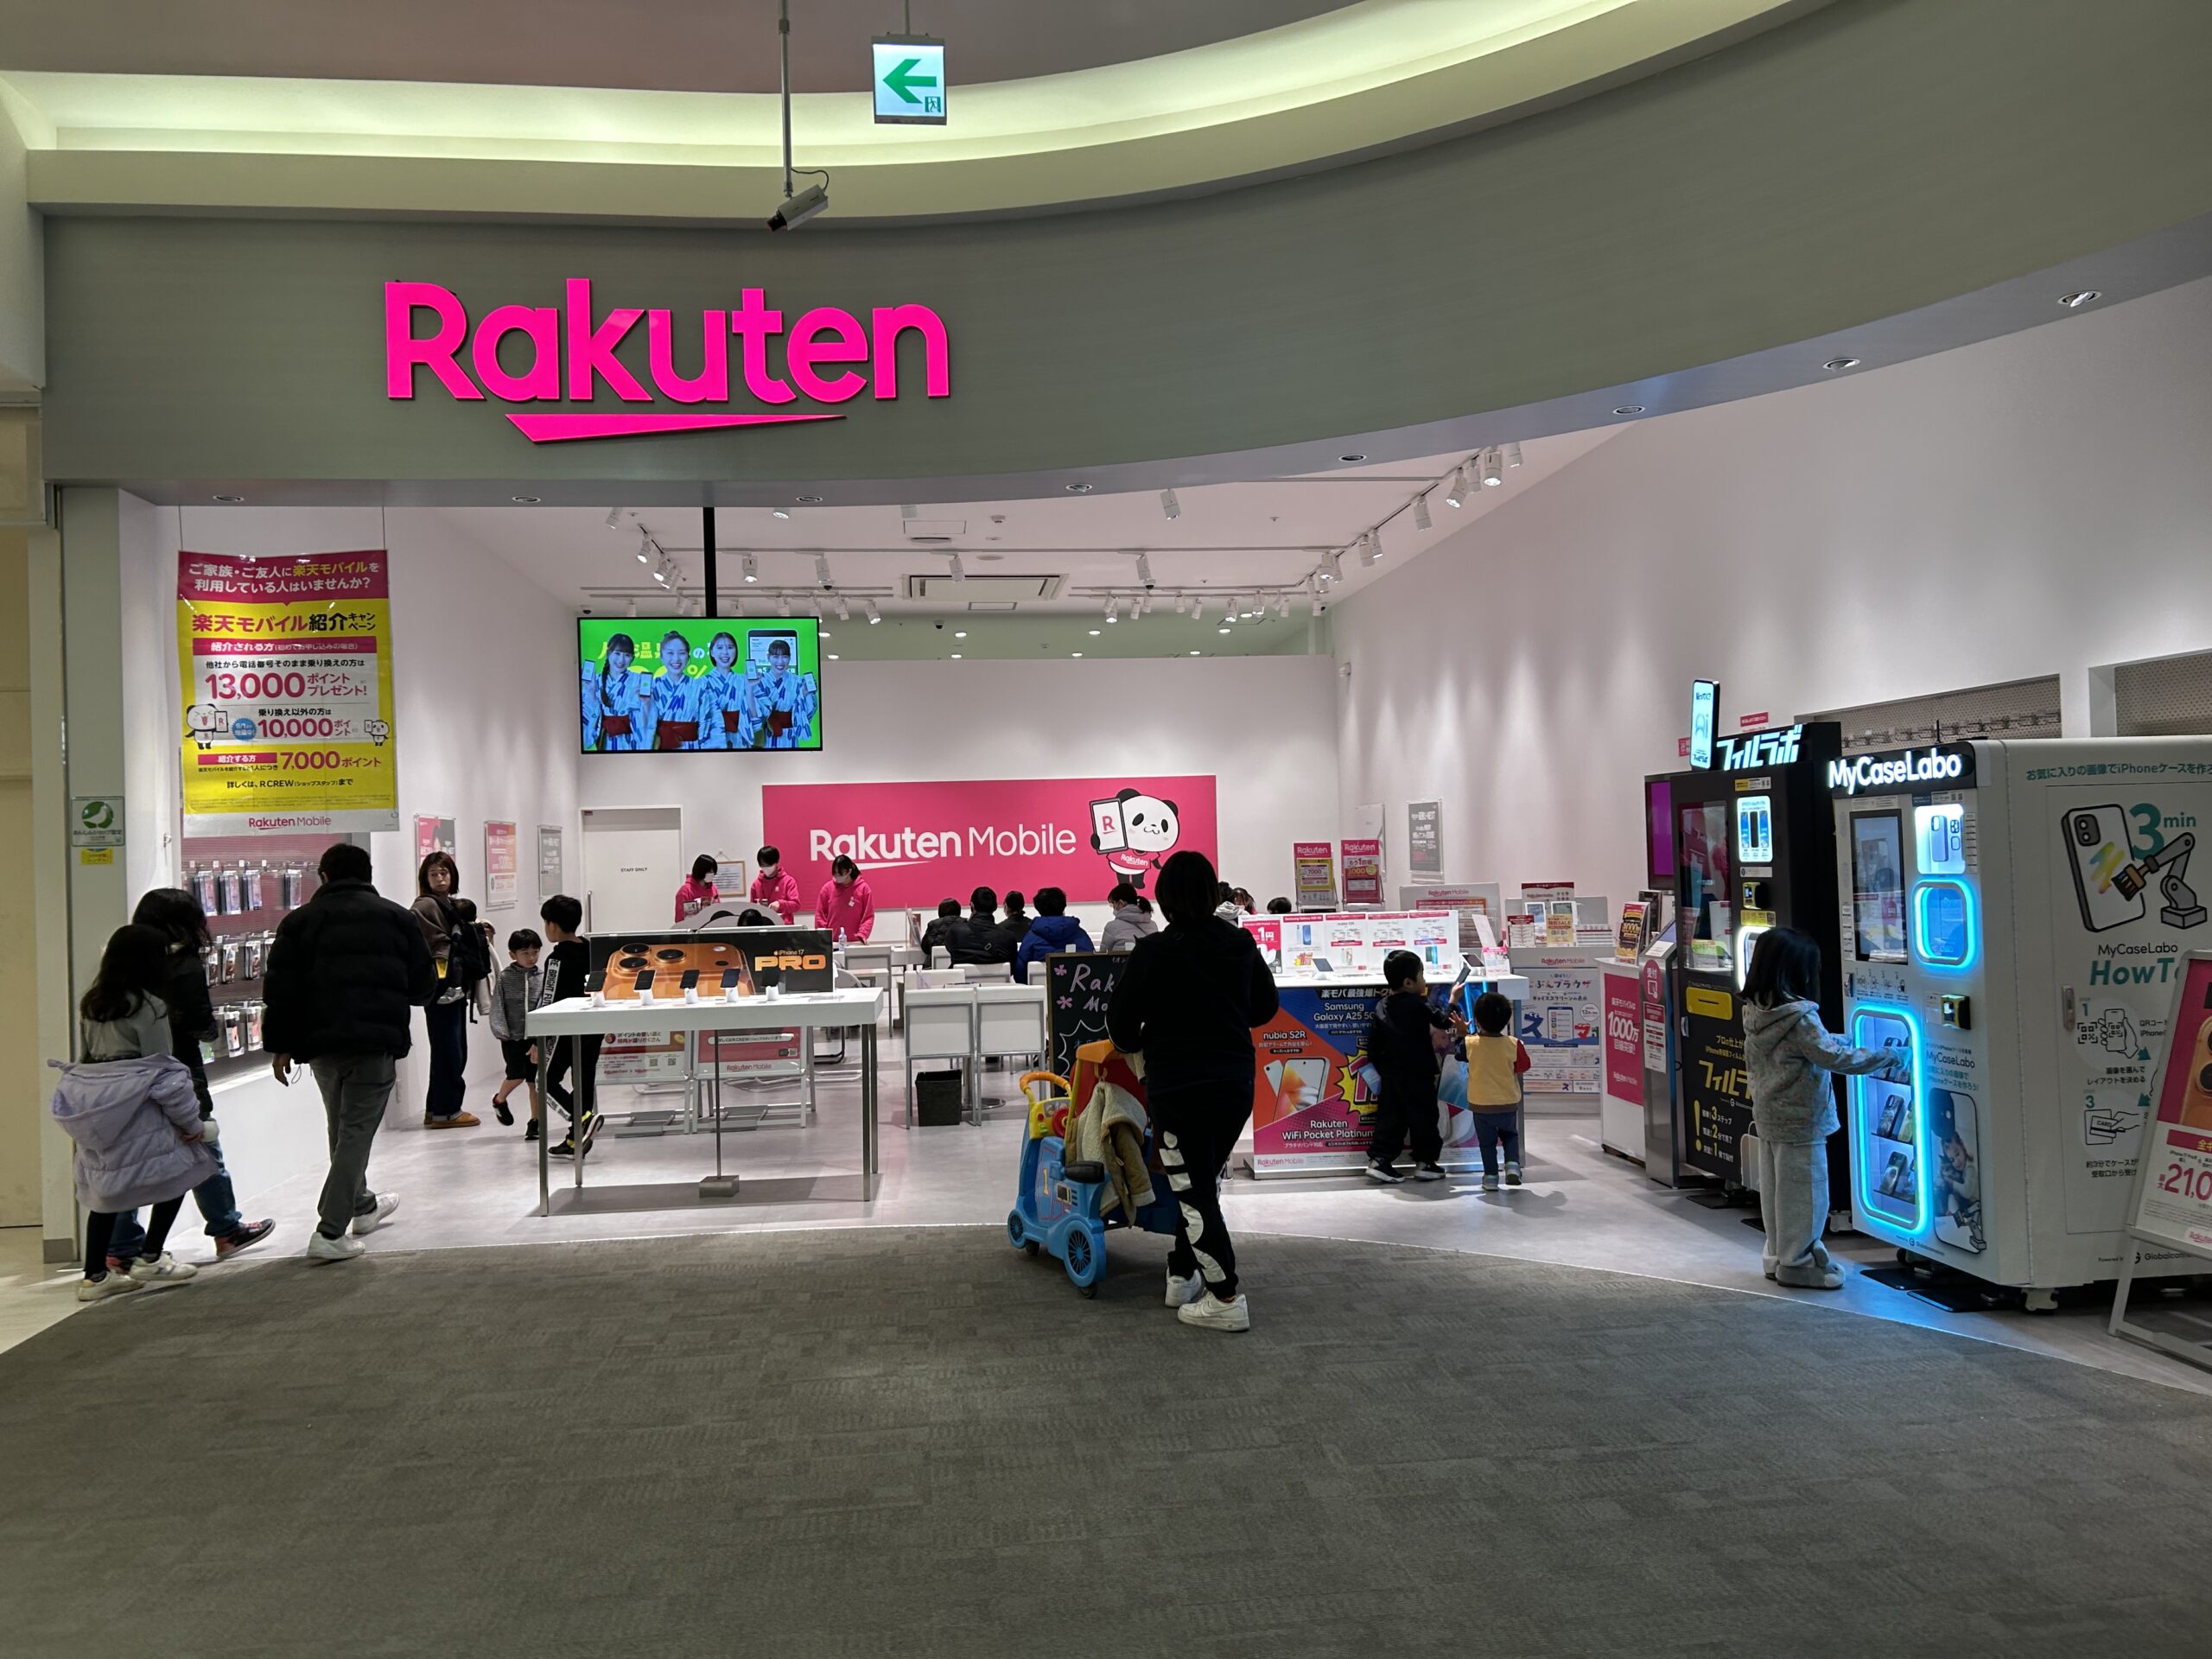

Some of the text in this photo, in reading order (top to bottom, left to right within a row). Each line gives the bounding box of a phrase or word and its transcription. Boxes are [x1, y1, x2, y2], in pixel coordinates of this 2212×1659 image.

[385, 278, 949, 404] Rakuten
[188, 562, 379, 579] ご家族・ご友人に楽天モバイルを
[194, 577, 371, 594] 利用している人はいませんか?
[192, 612, 347, 632] 楽天モバイル紹介
[205, 672, 306, 700] 13,000
[307, 673, 351, 684] ポイント
[307, 685, 367, 697] プレゼント!
[258, 709, 332, 717] 乗り換え以外の方は
[257, 718, 334, 739] 10,000
[1716, 724, 1803, 772] フィルラボ
[218, 755, 256, 764] 紹介する方
[280, 751, 341, 771] 7,000
[341, 757, 382, 768] ポイント
[1827, 747, 1962, 796] MyCaseLabo
[249, 816, 332, 829] Rakuten Mobile
[2163, 811, 2197, 829] min
[2129, 803, 2165, 861] 3
[810, 823, 1077, 861] Rakuten Mobile
[1344, 843, 1376, 852] Rakuten
[1121, 853, 1148, 867] Rakuten
[2098, 942, 2178, 958] MyCaseLabo
[754, 954, 826, 972] PRO
[2089, 957, 2180, 986] HowT
[1070, 963, 1115, 993] Rak
[1083, 995, 1109, 1013] Mo
[1325, 1002, 1364, 1012] Samsung
[2082, 1003, 2088, 1016] 1
[1313, 1013, 1344, 1022] Galaxy
[1345, 1012, 1362, 1020] A25
[1263, 1030, 1306, 1040] nubia S2R
[1926, 1050, 1975, 1068] MyCaseLabo
[2085, 1095, 2095, 1109] 3
[1310, 1120, 1348, 1129] Rakuten
[1303, 1131, 1335, 1140] Pocket
